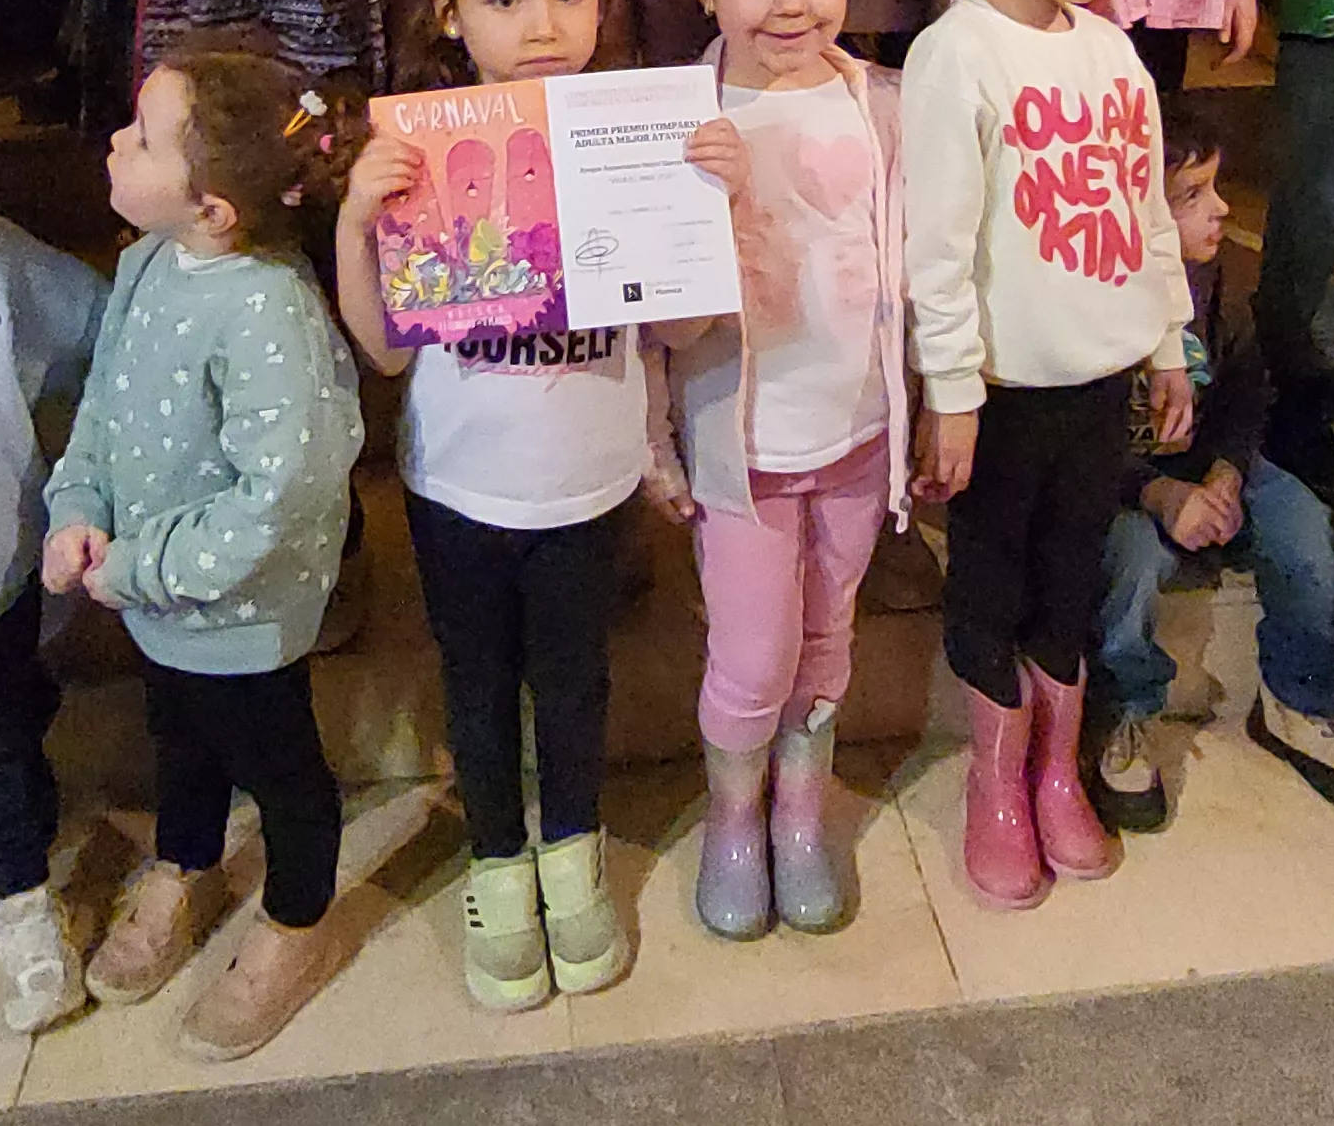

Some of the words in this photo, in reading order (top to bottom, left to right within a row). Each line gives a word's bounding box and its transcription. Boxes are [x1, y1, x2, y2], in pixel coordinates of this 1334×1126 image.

[395, 92, 524, 134] CARNAVAL
[570, 127, 609, 139] PRIMER
[611, 124, 649, 135] PREMIO
[1003, 86, 1093, 151] OU
[574, 137, 615, 149] ADULTA
[616, 133, 650, 144] MEJOR
[651, 130, 696, 142] ATAVIAD
[444, 329, 619, 366] OURSELF
